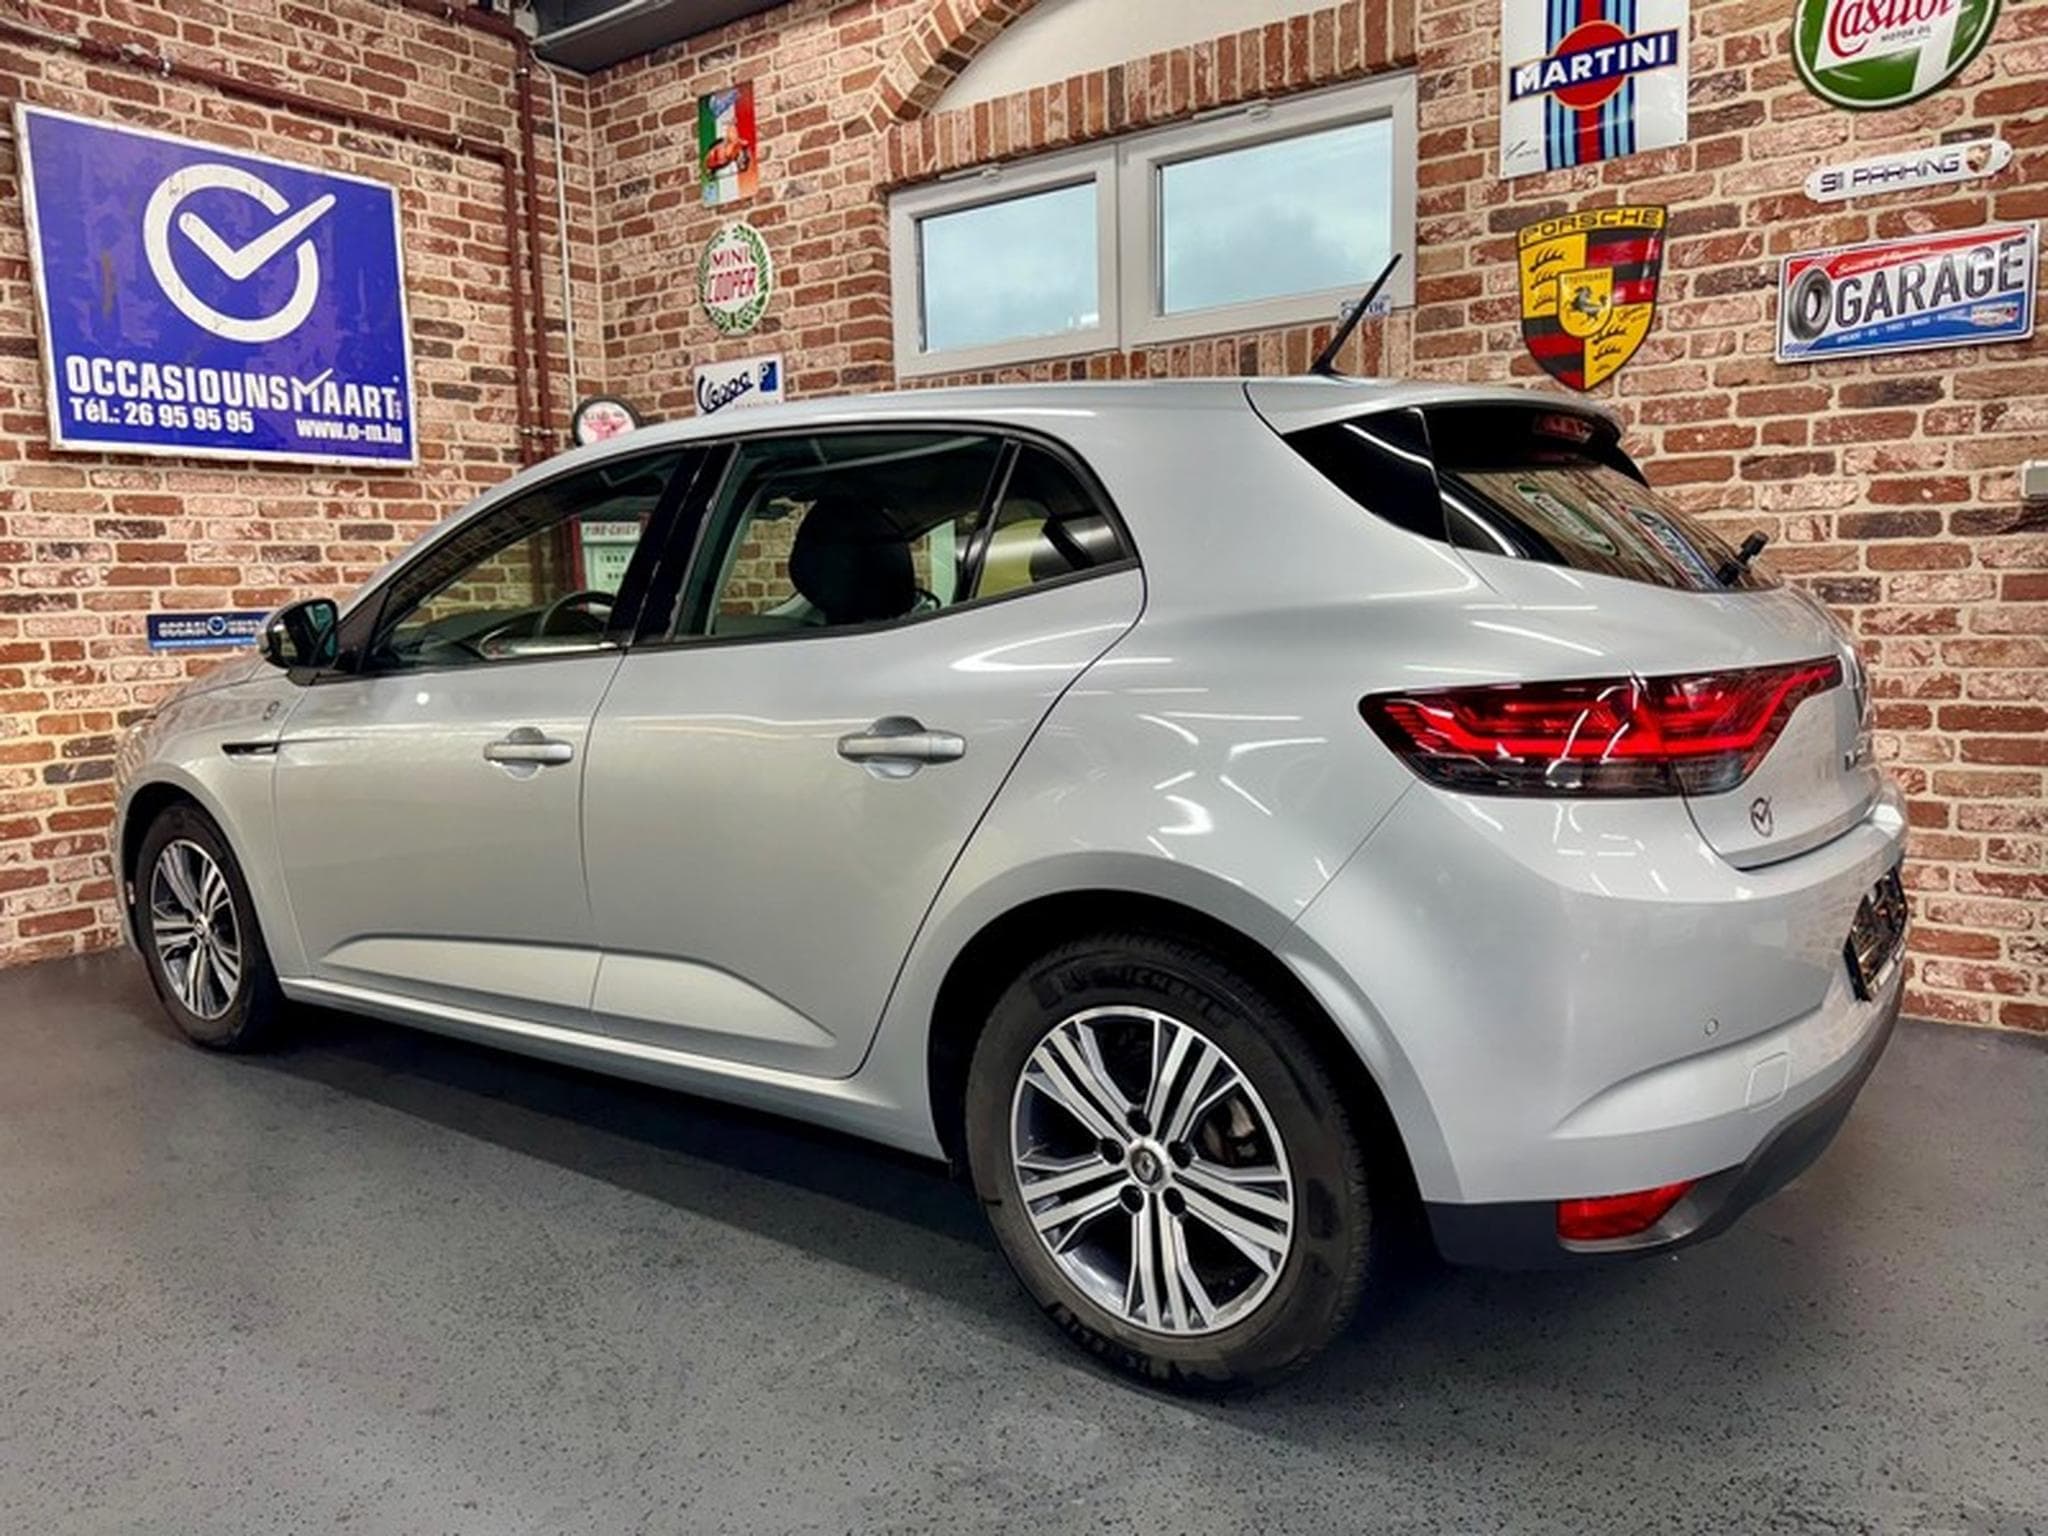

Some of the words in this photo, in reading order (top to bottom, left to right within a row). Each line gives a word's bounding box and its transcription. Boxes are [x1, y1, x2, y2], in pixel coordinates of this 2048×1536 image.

[1515, 35, 1669, 96] MARTINI
[1853, 153, 1960, 186] PARKING
[1523, 208, 1658, 244] PORSCHE
[713, 250, 749, 268] MINI
[708, 266, 757, 303] COOPER
[1835, 237, 2027, 328] GARAGE
[698, 371, 754, 413] Vespa
[69, 398, 121, 424] Tél.:
[124, 402, 154, 426] 26
[159, 404, 188, 428] 95
[193, 407, 222, 431] 95
[226, 410, 254, 433] 95
[296, 418, 403, 444] www.o-m.lu
